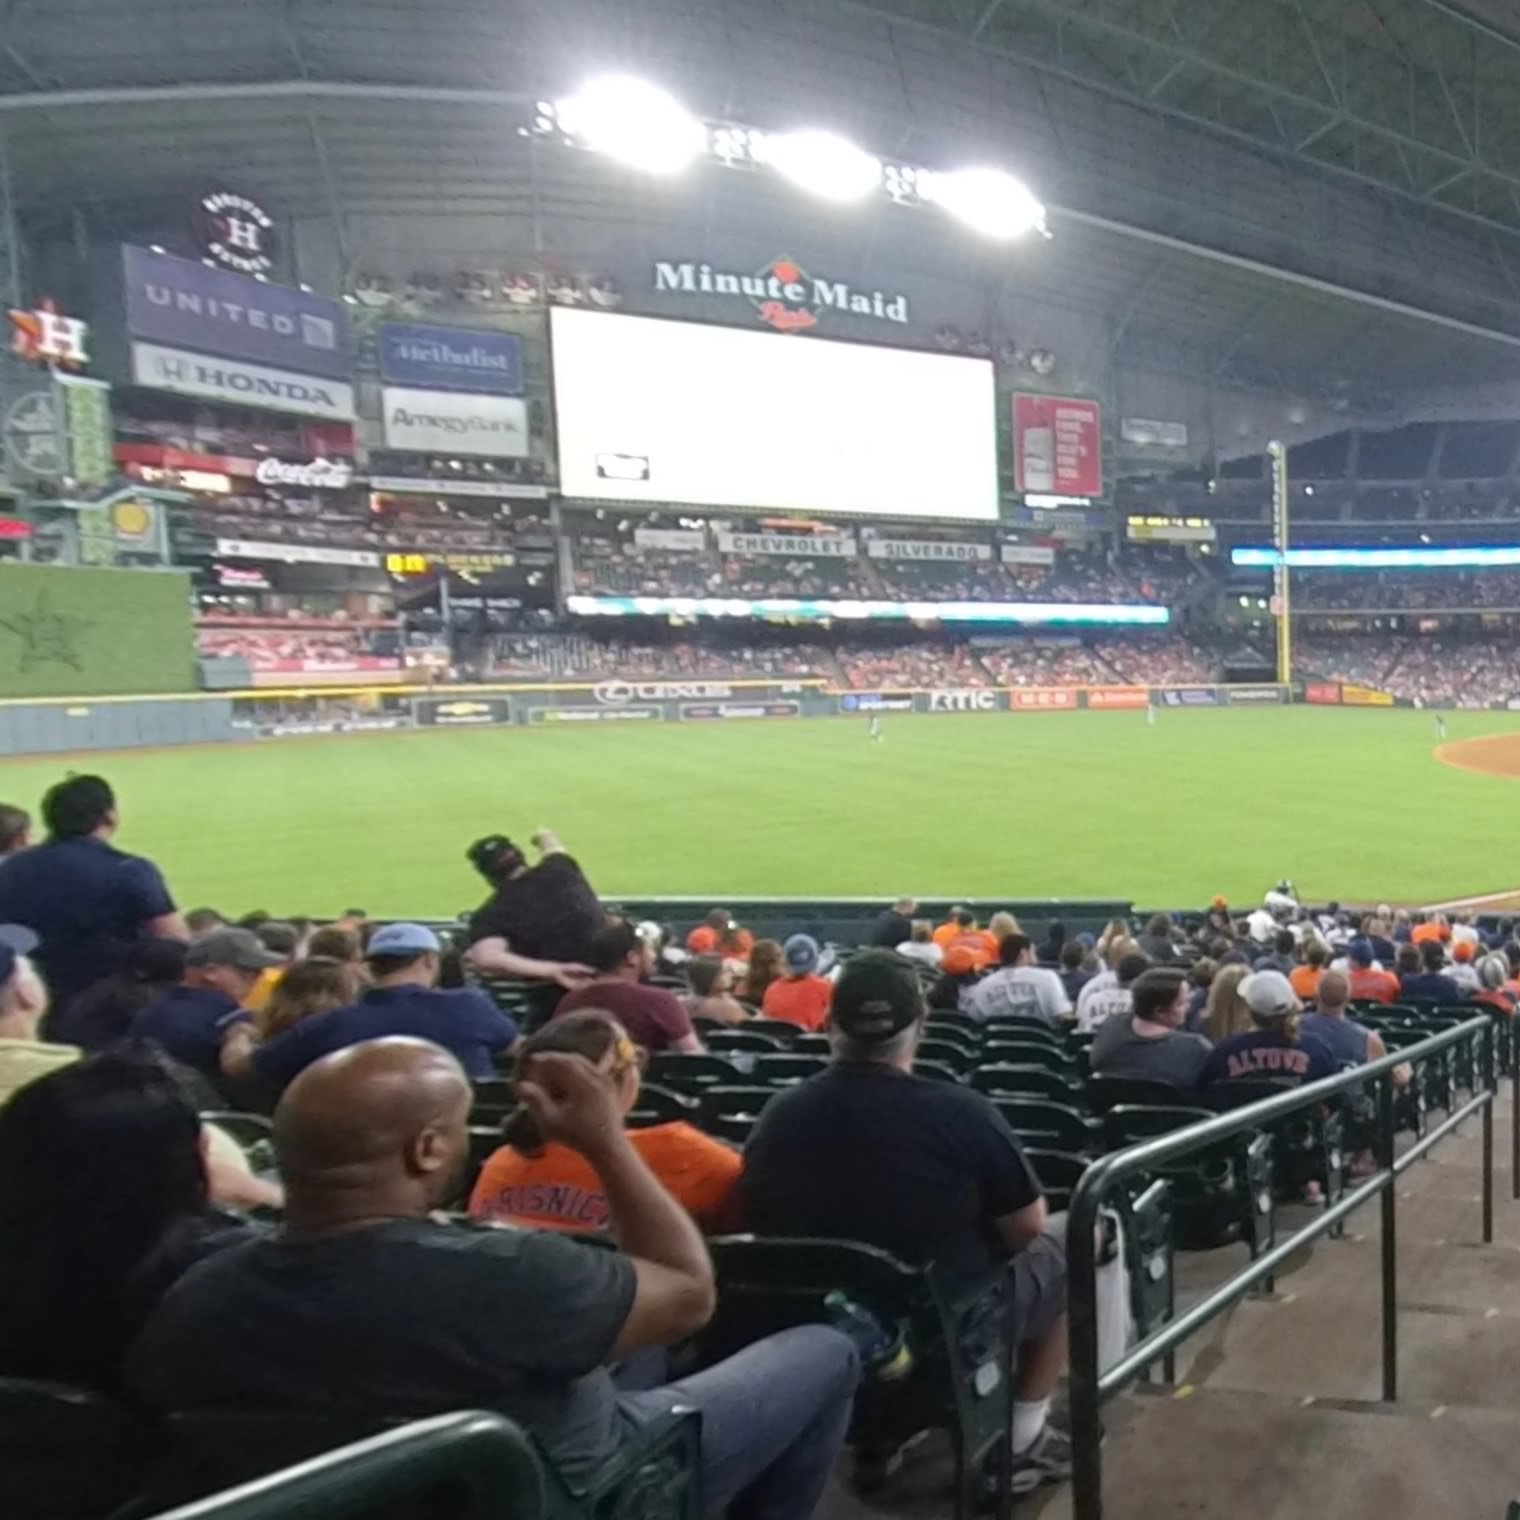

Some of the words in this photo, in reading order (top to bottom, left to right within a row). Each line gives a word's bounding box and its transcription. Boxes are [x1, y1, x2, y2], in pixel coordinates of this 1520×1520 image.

[145, 283, 296, 335] UNITED
[655, 261, 804, 302] Minute
[812, 278, 908, 324] Maid
[195, 364, 337, 408] HONDA
[732, 535, 845, 554] CHEVROLET
[884, 542, 980, 560] SILVERADO
[1227, 1047, 1311, 1077] ALTUVE
